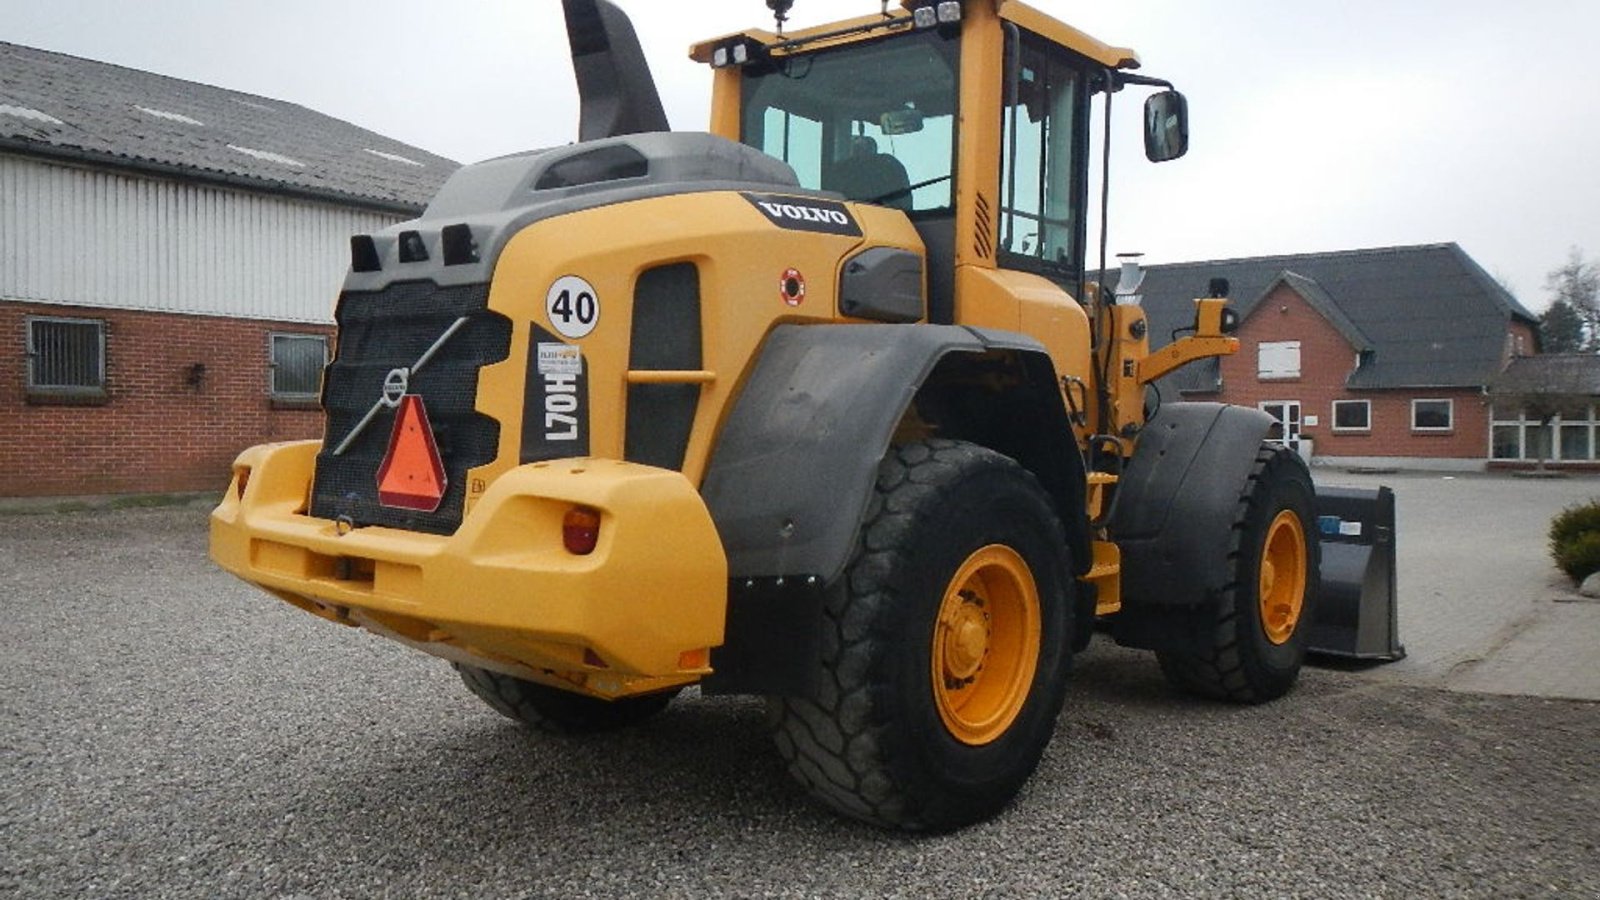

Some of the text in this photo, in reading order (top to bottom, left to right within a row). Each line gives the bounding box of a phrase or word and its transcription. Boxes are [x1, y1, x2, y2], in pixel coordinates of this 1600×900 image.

[758, 201, 848, 225] VOLVO
[551, 289, 595, 324] 40
[545, 373, 577, 440] L70H
